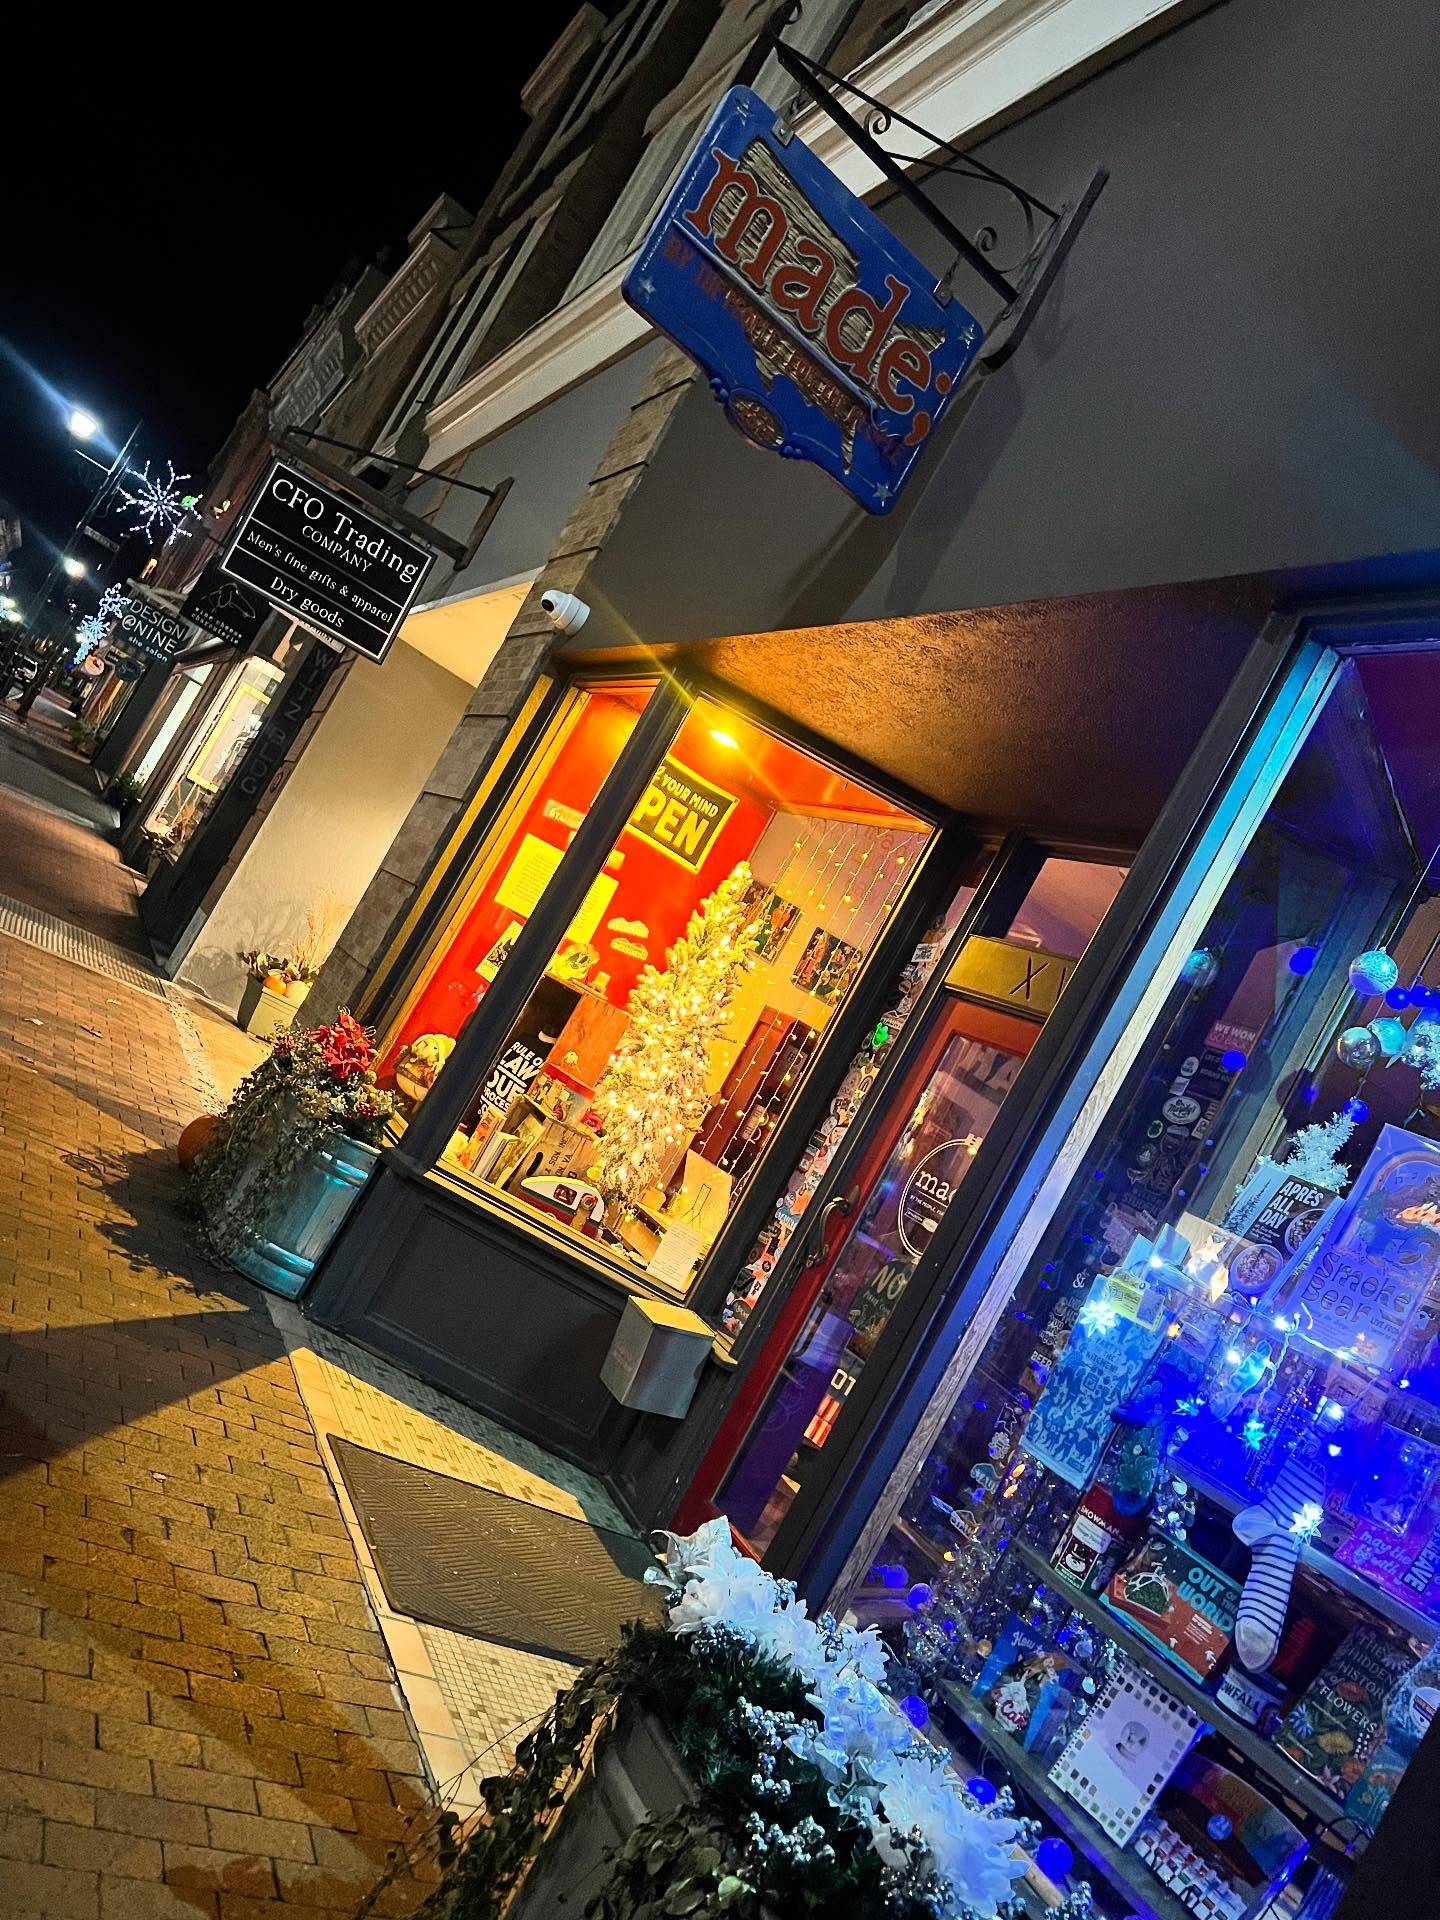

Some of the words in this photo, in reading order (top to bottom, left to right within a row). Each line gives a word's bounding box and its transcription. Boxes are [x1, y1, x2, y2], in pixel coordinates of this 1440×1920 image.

[272, 479, 324, 520] CFO
[333, 511, 419, 583] Trading
[302, 525, 373, 573] COMPANY
[247, 531, 281, 558] Men's
[284, 551, 308, 573] fine
[309, 568, 337, 590] gifts
[340, 585, 349, 596] &
[351, 592, 393, 623] apparel
[130, 600, 185, 640] DESIGN
[270, 576, 299, 602] Dry
[300, 598, 345, 628] goods
[122, 614, 178, 653] @NINE
[128, 636, 143, 648] she
[145, 646, 168, 662] salon
[661, 774, 691, 801] YOUR
[689, 793, 719, 818] MIND
[631, 784, 710, 855] PEN
[500, 1049, 540, 1080] LAW
[511, 1041, 535, 1061] RULE
[1268, 1195, 1295, 1216] ALL
[1279, 1182, 1324, 1207] APRÈS
[1259, 1207, 1288, 1229] DAY
[871, 1264, 907, 1301] NO
[1072, 1272, 1086, 1289] &
[1301, 1274, 1372, 1323] Bear
[1314, 1251, 1412, 1313] Smoke
[1030, 1350, 1053, 1368] BEER
[1360, 1531, 1392, 1555] may
[1188, 1567, 1225, 1598] OUT
[1176, 1581, 1234, 1632] WORLD
[1011, 1631, 1036, 1650] How
[1359, 1634, 1387, 1657] THE
[1338, 1661, 1386, 1699] HISTOR
[1347, 1647, 1395, 1686] HIDDEN
[1320, 1687, 1378, 1733] FLOWERS
